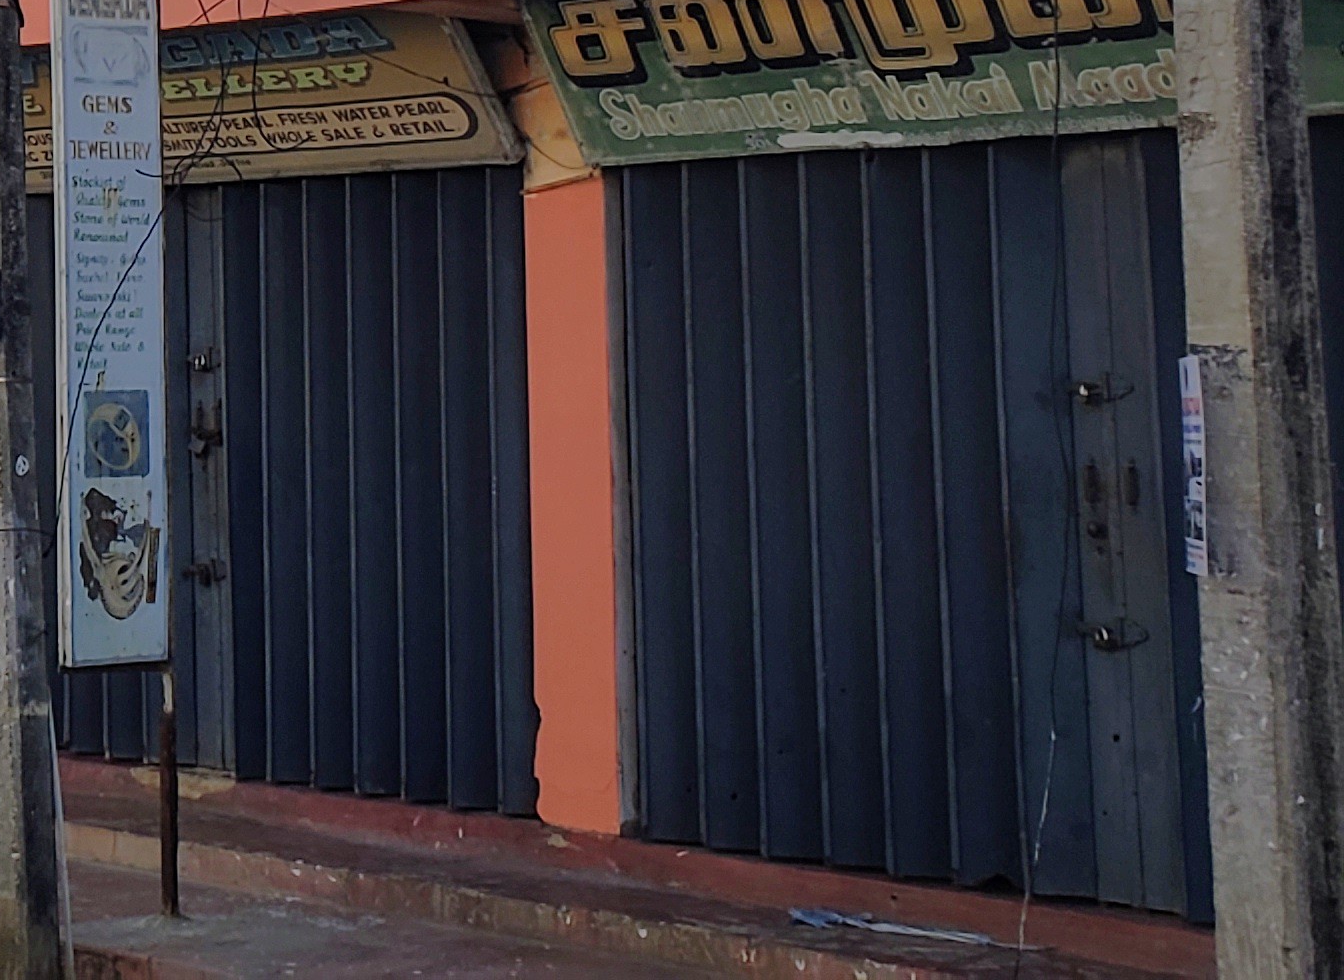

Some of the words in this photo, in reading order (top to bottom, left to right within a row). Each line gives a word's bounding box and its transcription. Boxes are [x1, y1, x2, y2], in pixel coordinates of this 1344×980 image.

[82, 95, 133, 114] GEMS
[599, 78, 868, 140] Shanmugha
[863, 62, 1024, 121] Nakai
[1028, 48, 1178, 112] Maad
[278, 111, 328, 127] FRESH
[333, 104, 391, 122] WATER
[103, 121, 118, 136] &
[208, 134, 257, 150] TOOLS
[266, 131, 318, 146] WHOLE
[324, 126, 364, 141] SALE
[69, 140, 152, 161] JEWELLERY
